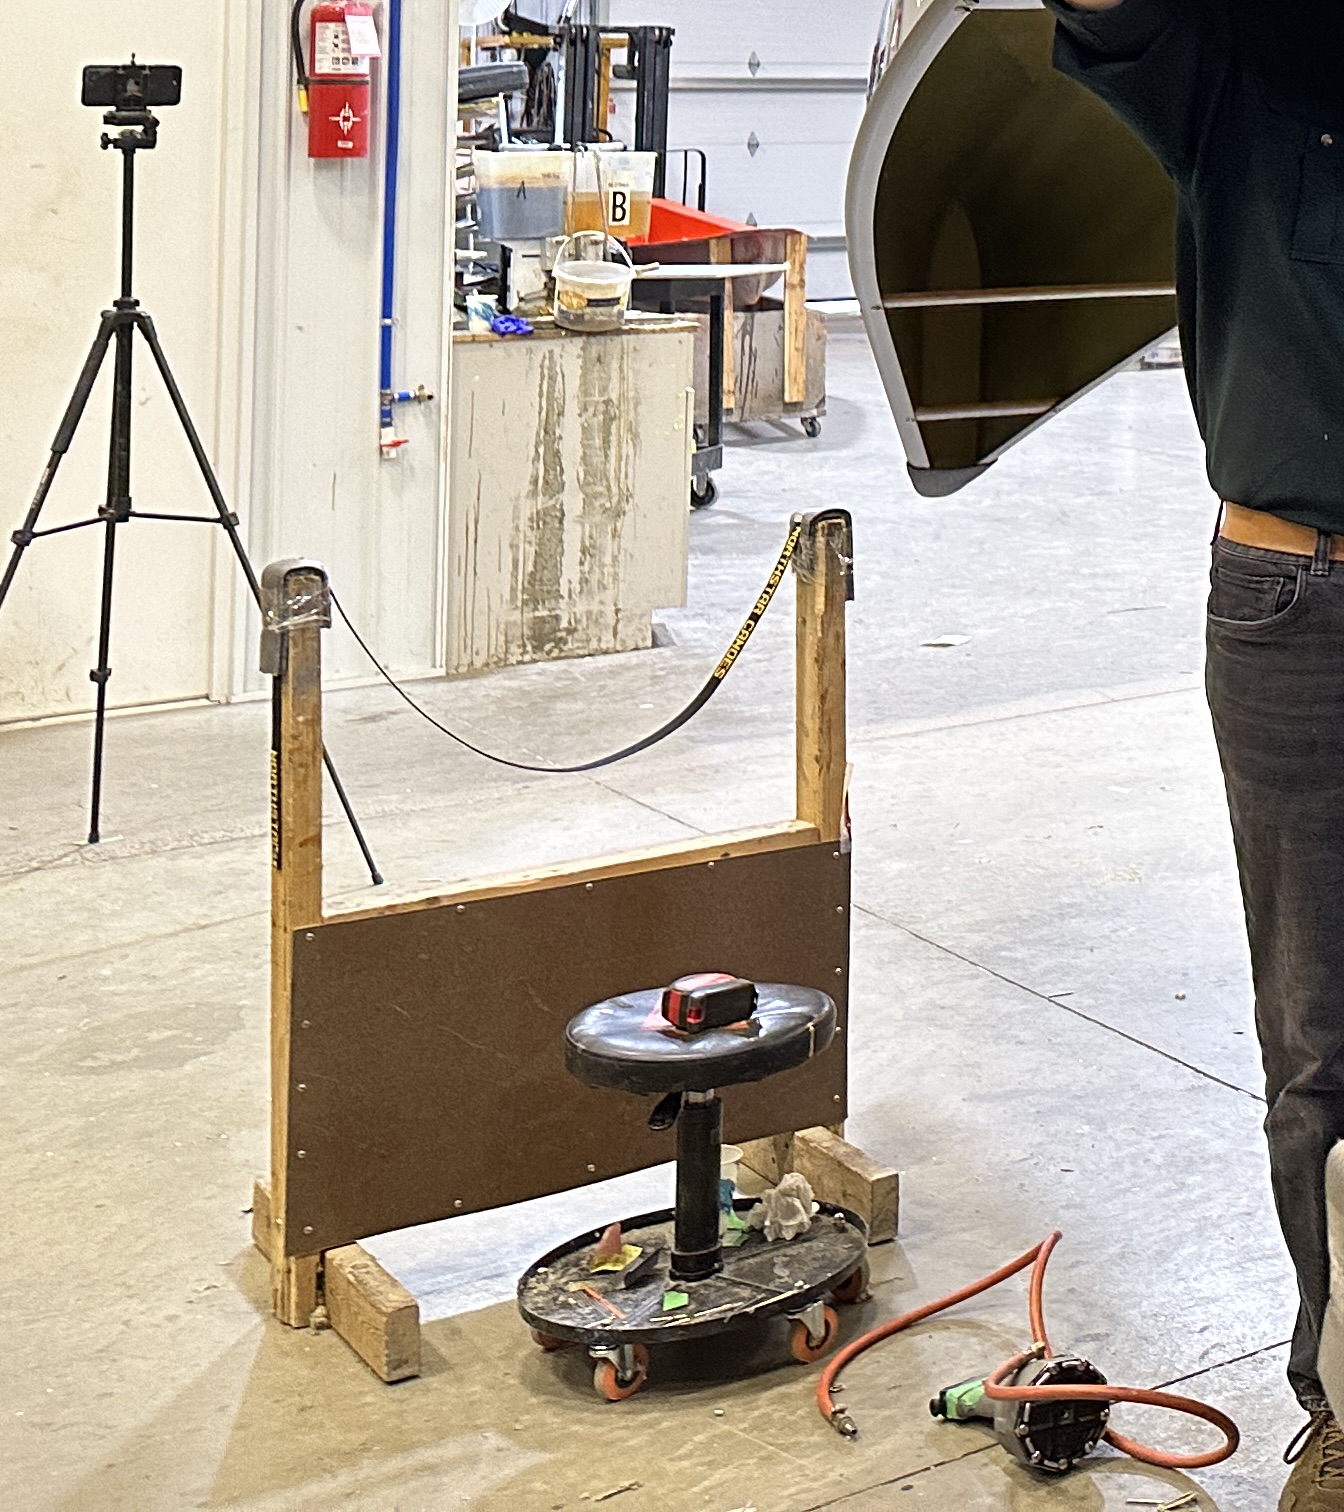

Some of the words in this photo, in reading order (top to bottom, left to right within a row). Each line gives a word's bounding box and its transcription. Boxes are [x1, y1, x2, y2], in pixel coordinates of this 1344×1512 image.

[612, 191, 627, 223] B
[752, 526, 801, 616] NORTHSTAR
[714, 619, 755, 680] CANOES
